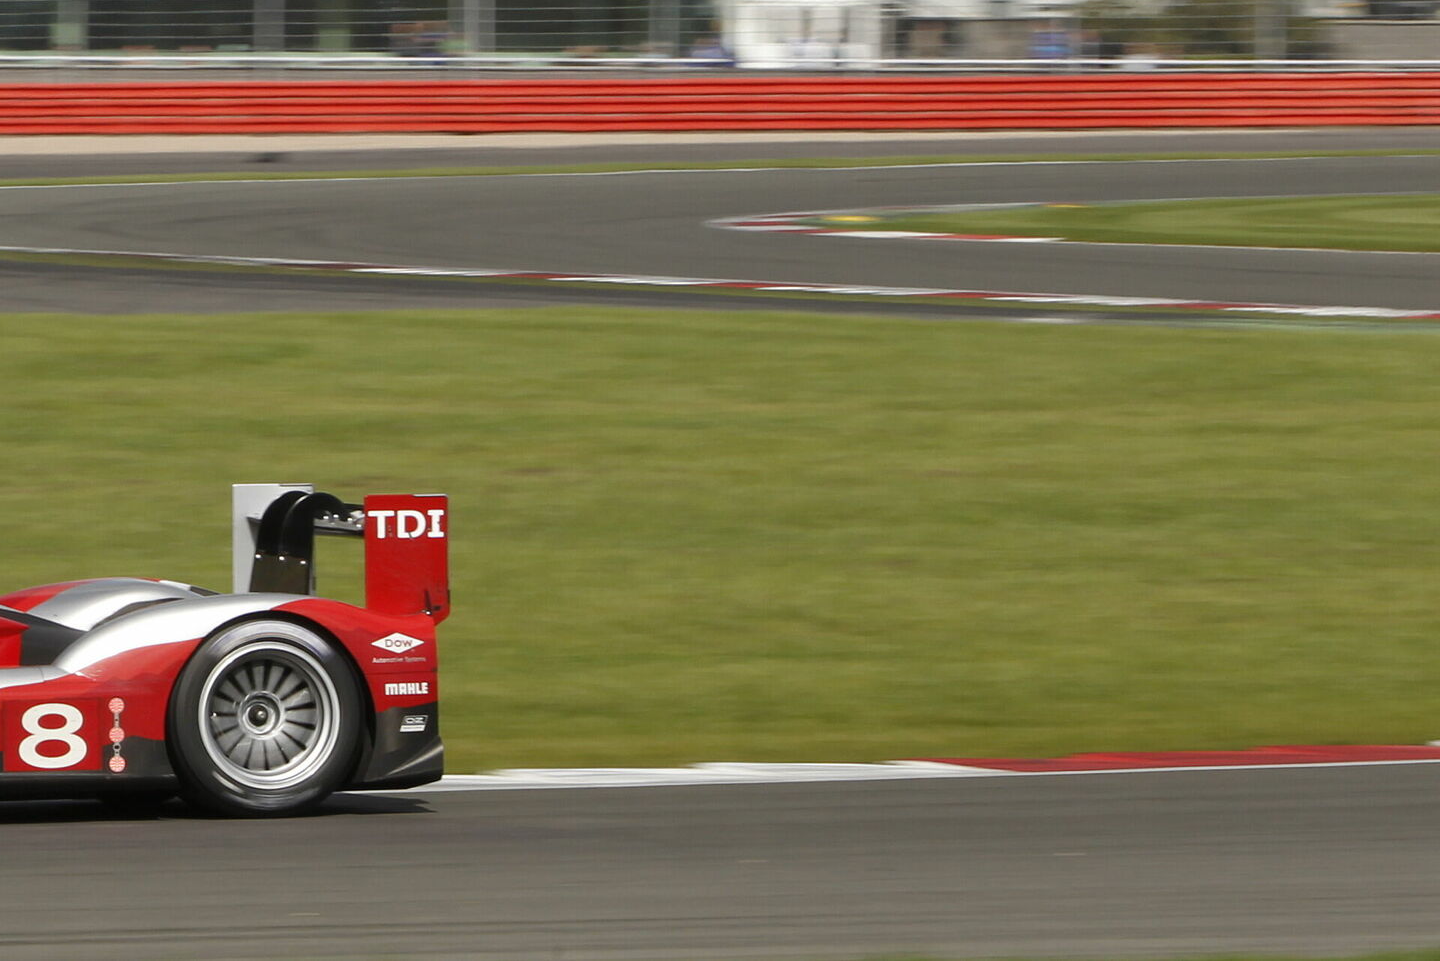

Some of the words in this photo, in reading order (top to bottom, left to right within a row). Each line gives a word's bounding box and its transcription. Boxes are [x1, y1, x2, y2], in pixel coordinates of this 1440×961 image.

[367, 509, 445, 539] TDI
[385, 639, 413, 648] DOW
[384, 682, 429, 696] MAHLE
[18, 702, 88, 769] 8
